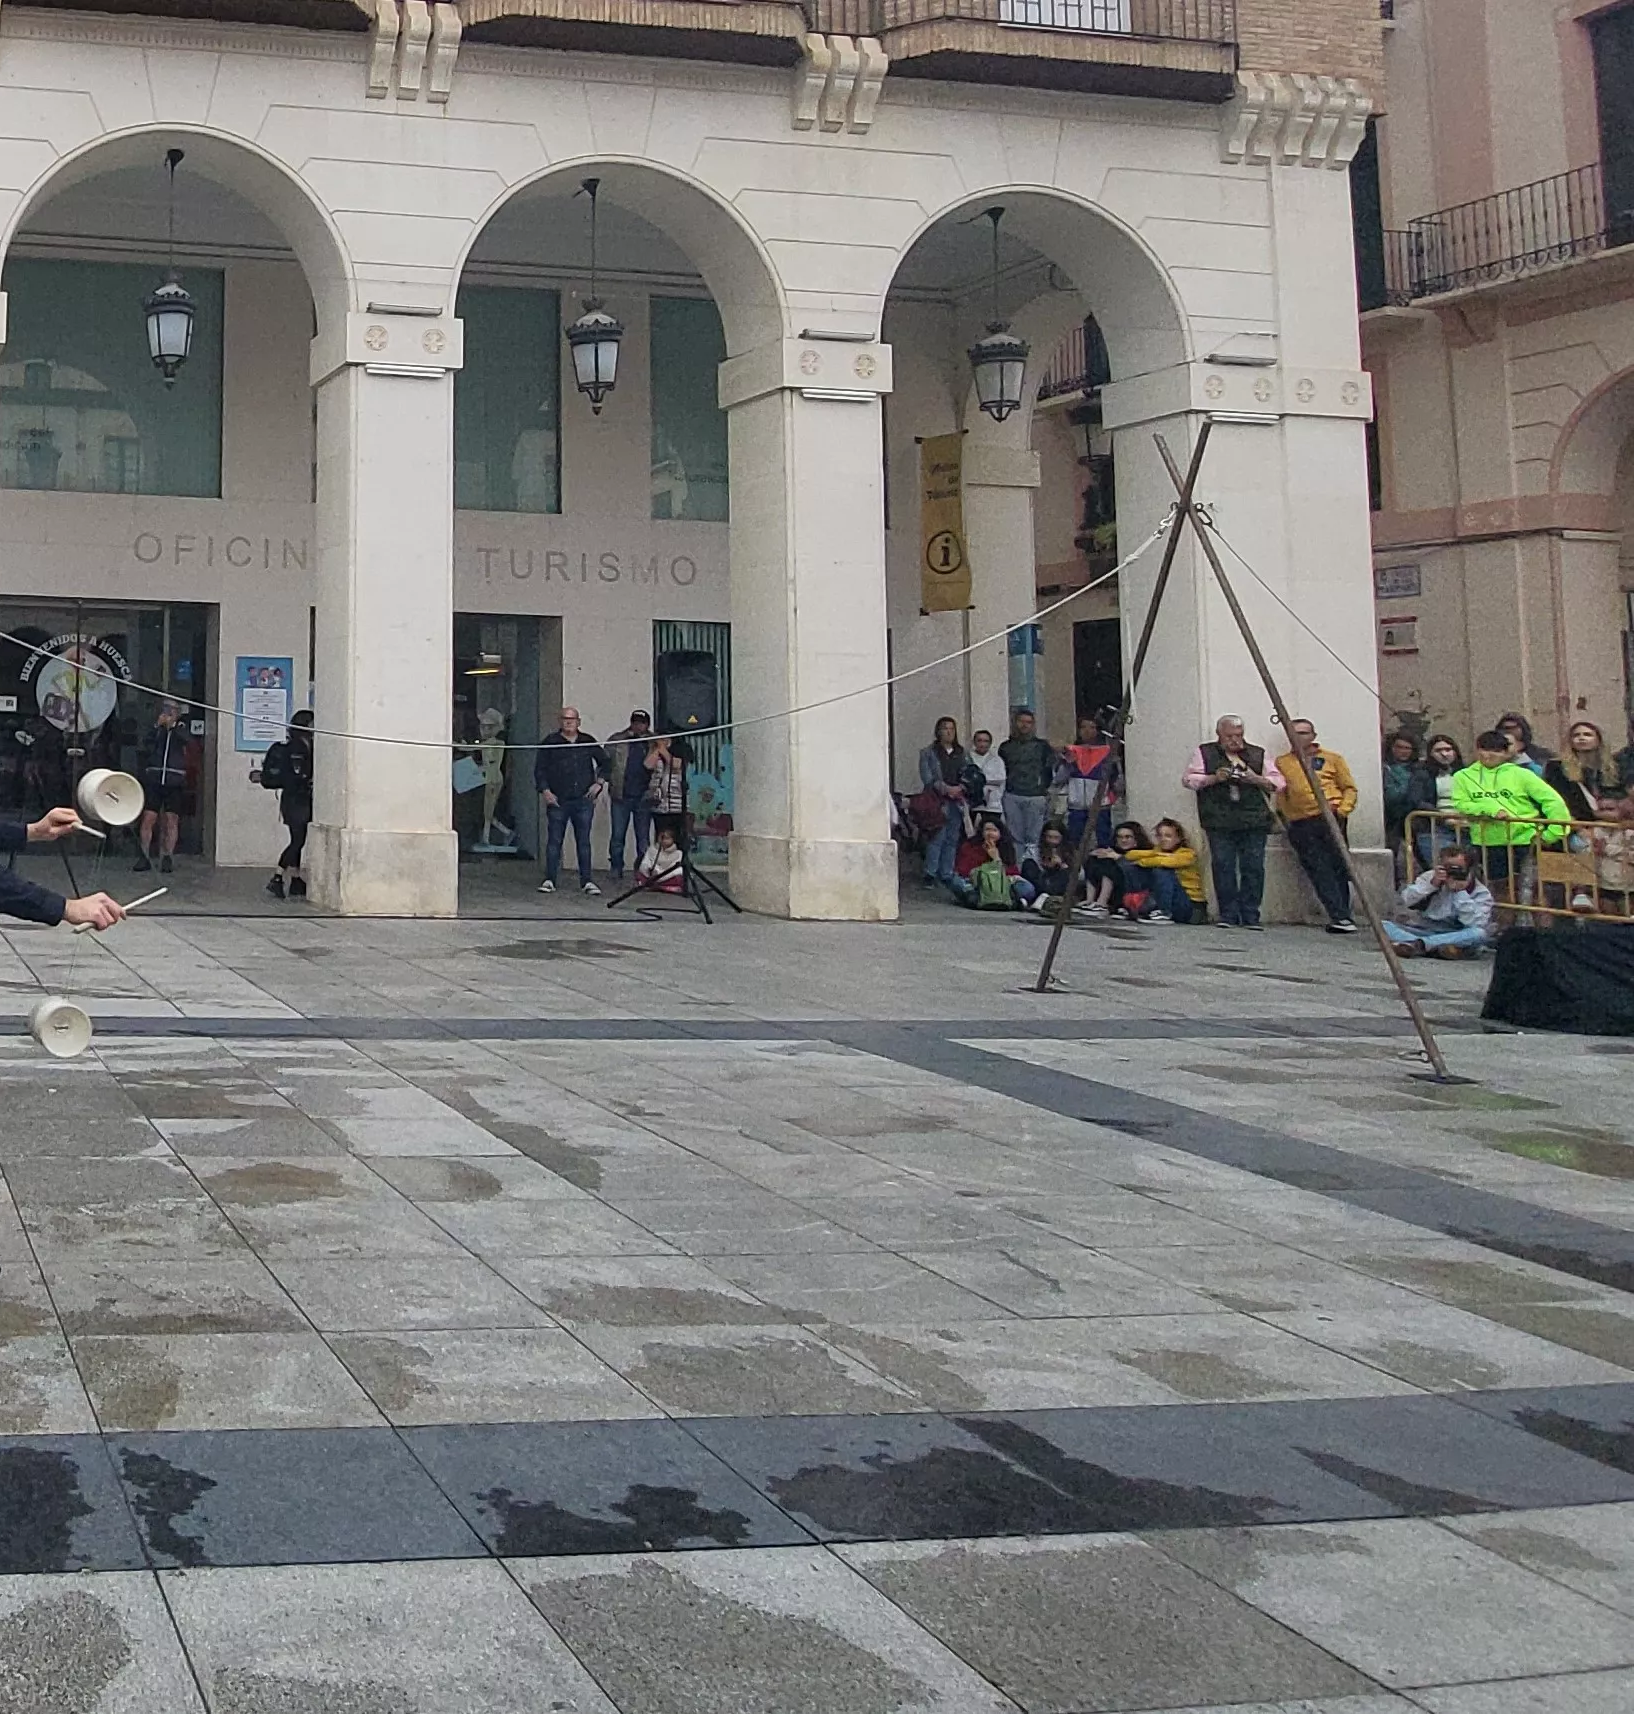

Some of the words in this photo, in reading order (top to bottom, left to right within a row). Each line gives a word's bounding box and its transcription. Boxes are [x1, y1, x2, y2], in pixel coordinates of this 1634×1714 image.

[133, 532, 308, 571] OFICIN
[476, 547, 697, 587] TURISMO
[88, 635, 97, 647] A
